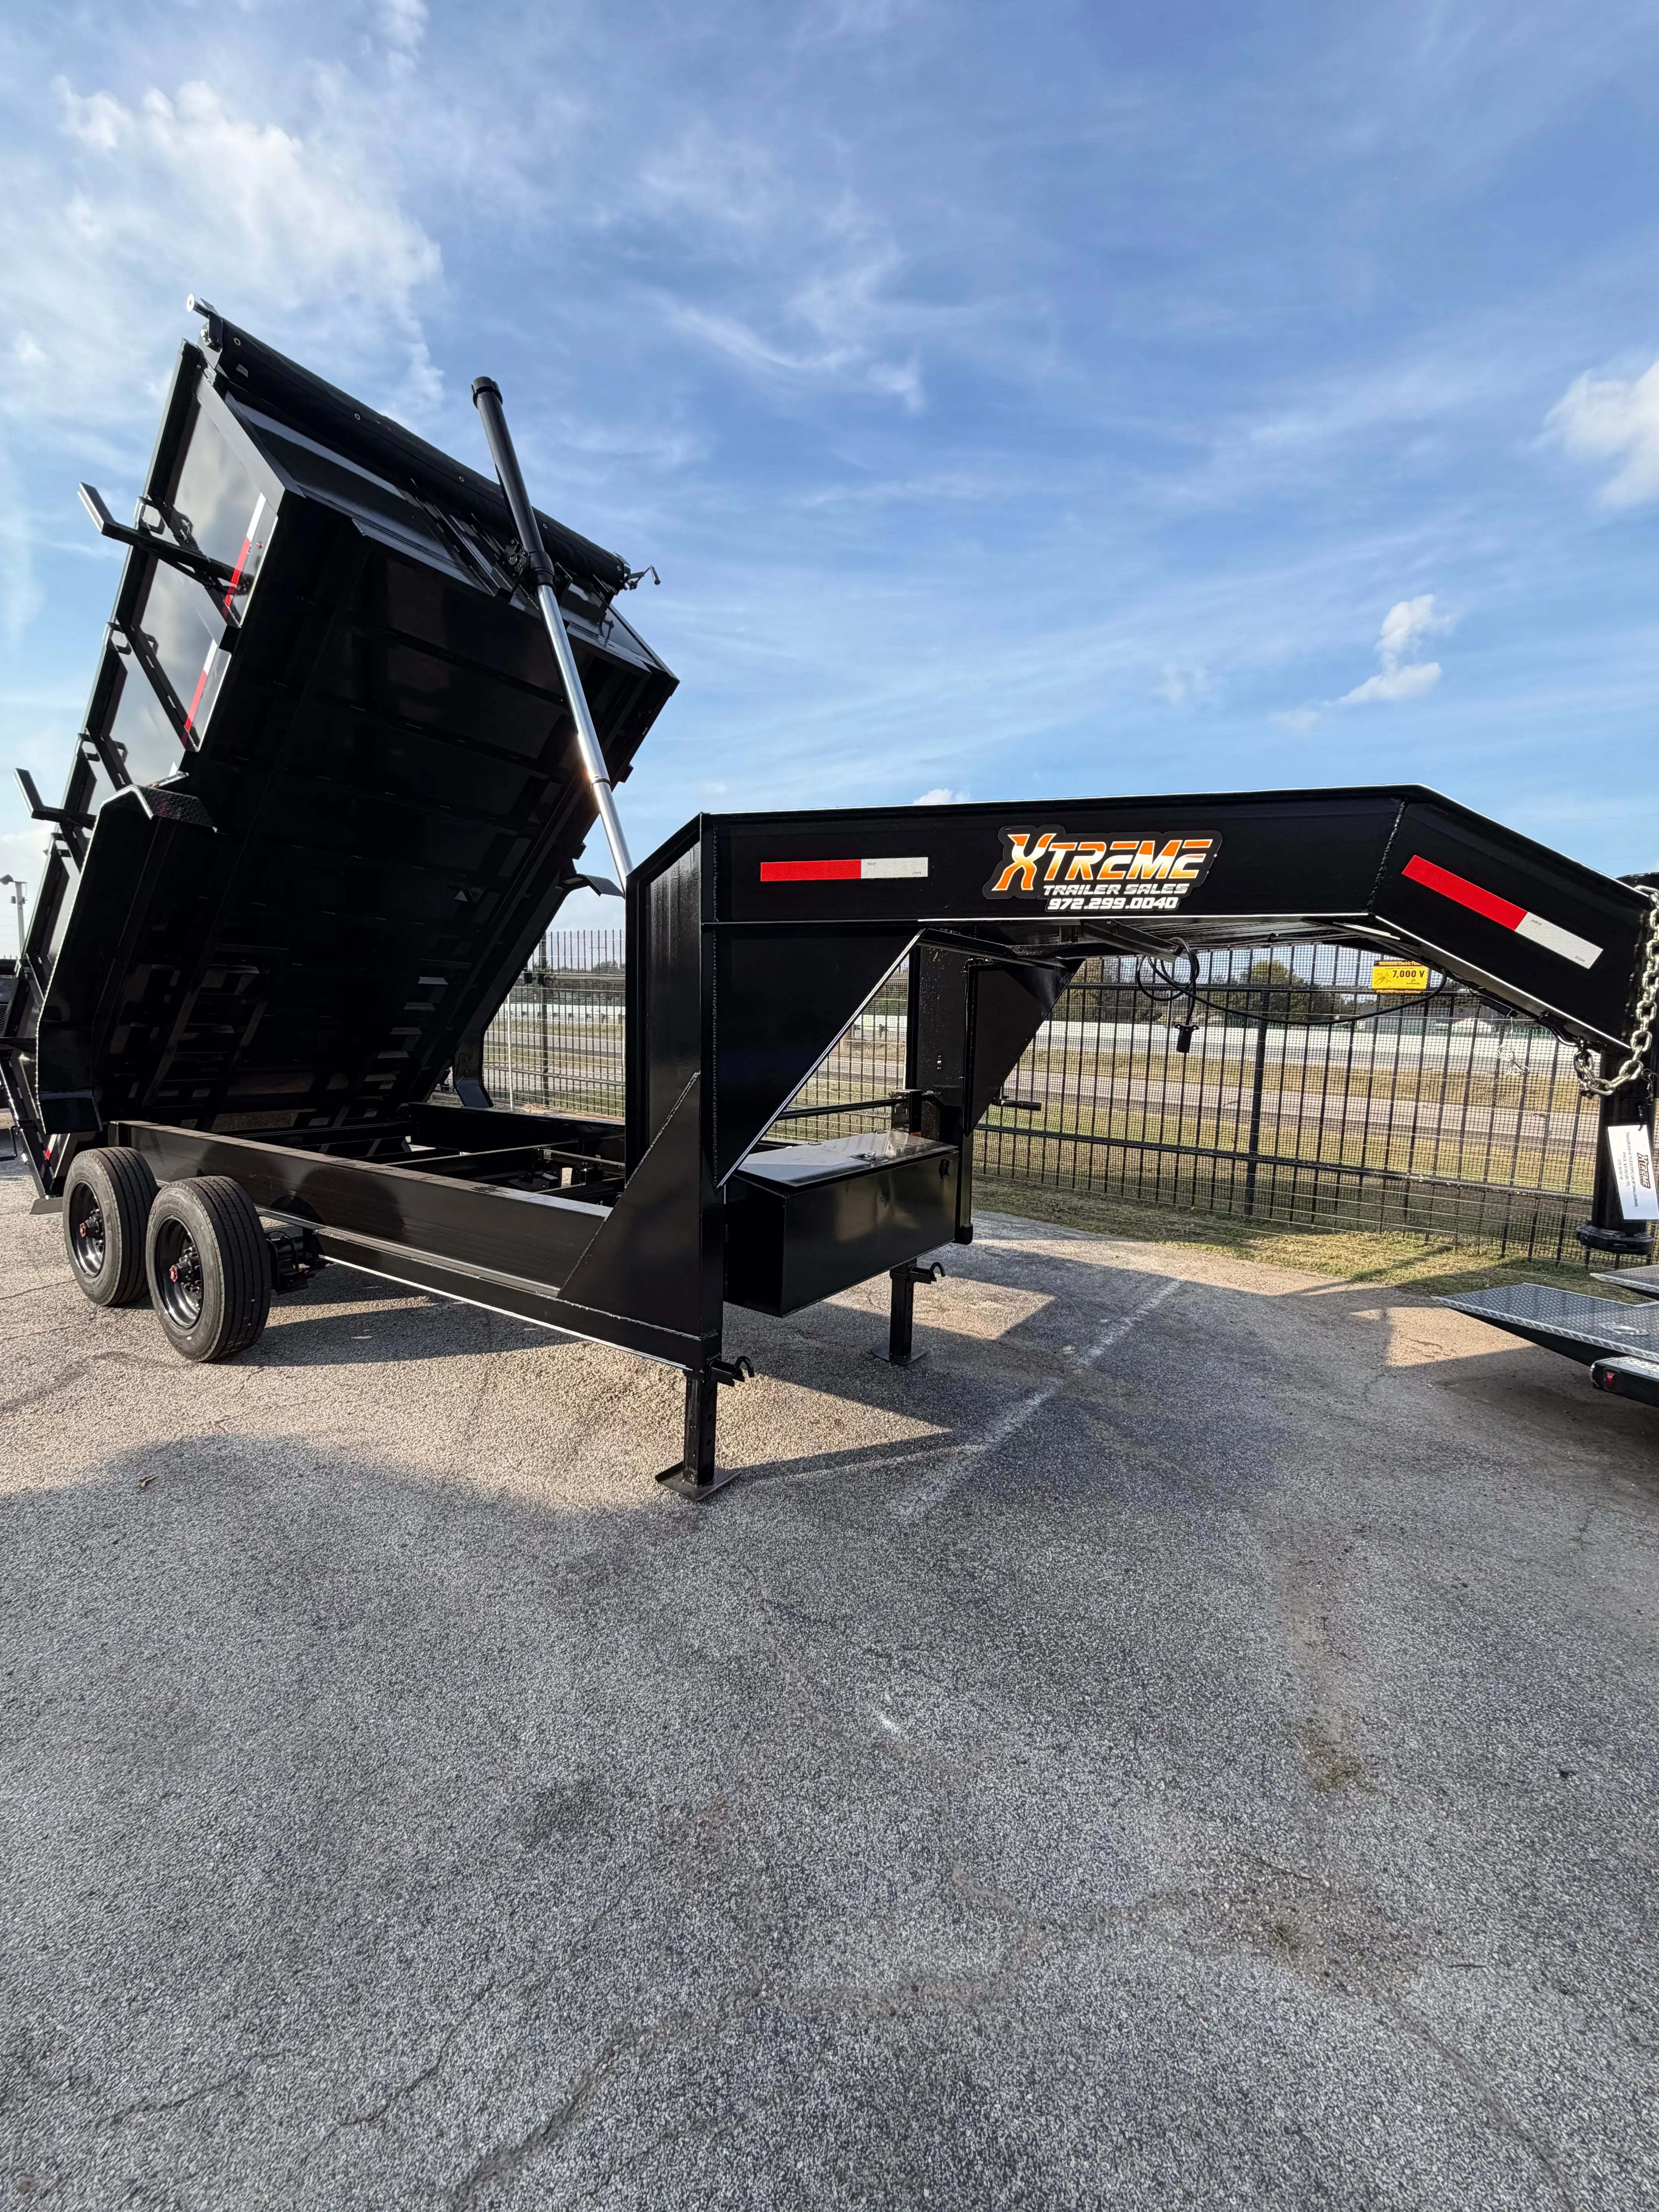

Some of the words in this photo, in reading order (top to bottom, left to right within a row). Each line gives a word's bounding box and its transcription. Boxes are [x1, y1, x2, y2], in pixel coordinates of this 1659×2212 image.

[991, 833, 1213, 891] XTREME
[1044, 884, 1120, 896] TRAILER
[1124, 884, 1189, 895] SALES
[1048, 897, 1178, 910] 972.299.0040
[1393, 970, 1416, 979] 7,000
[1638, 1154, 1651, 1188] XTREME
